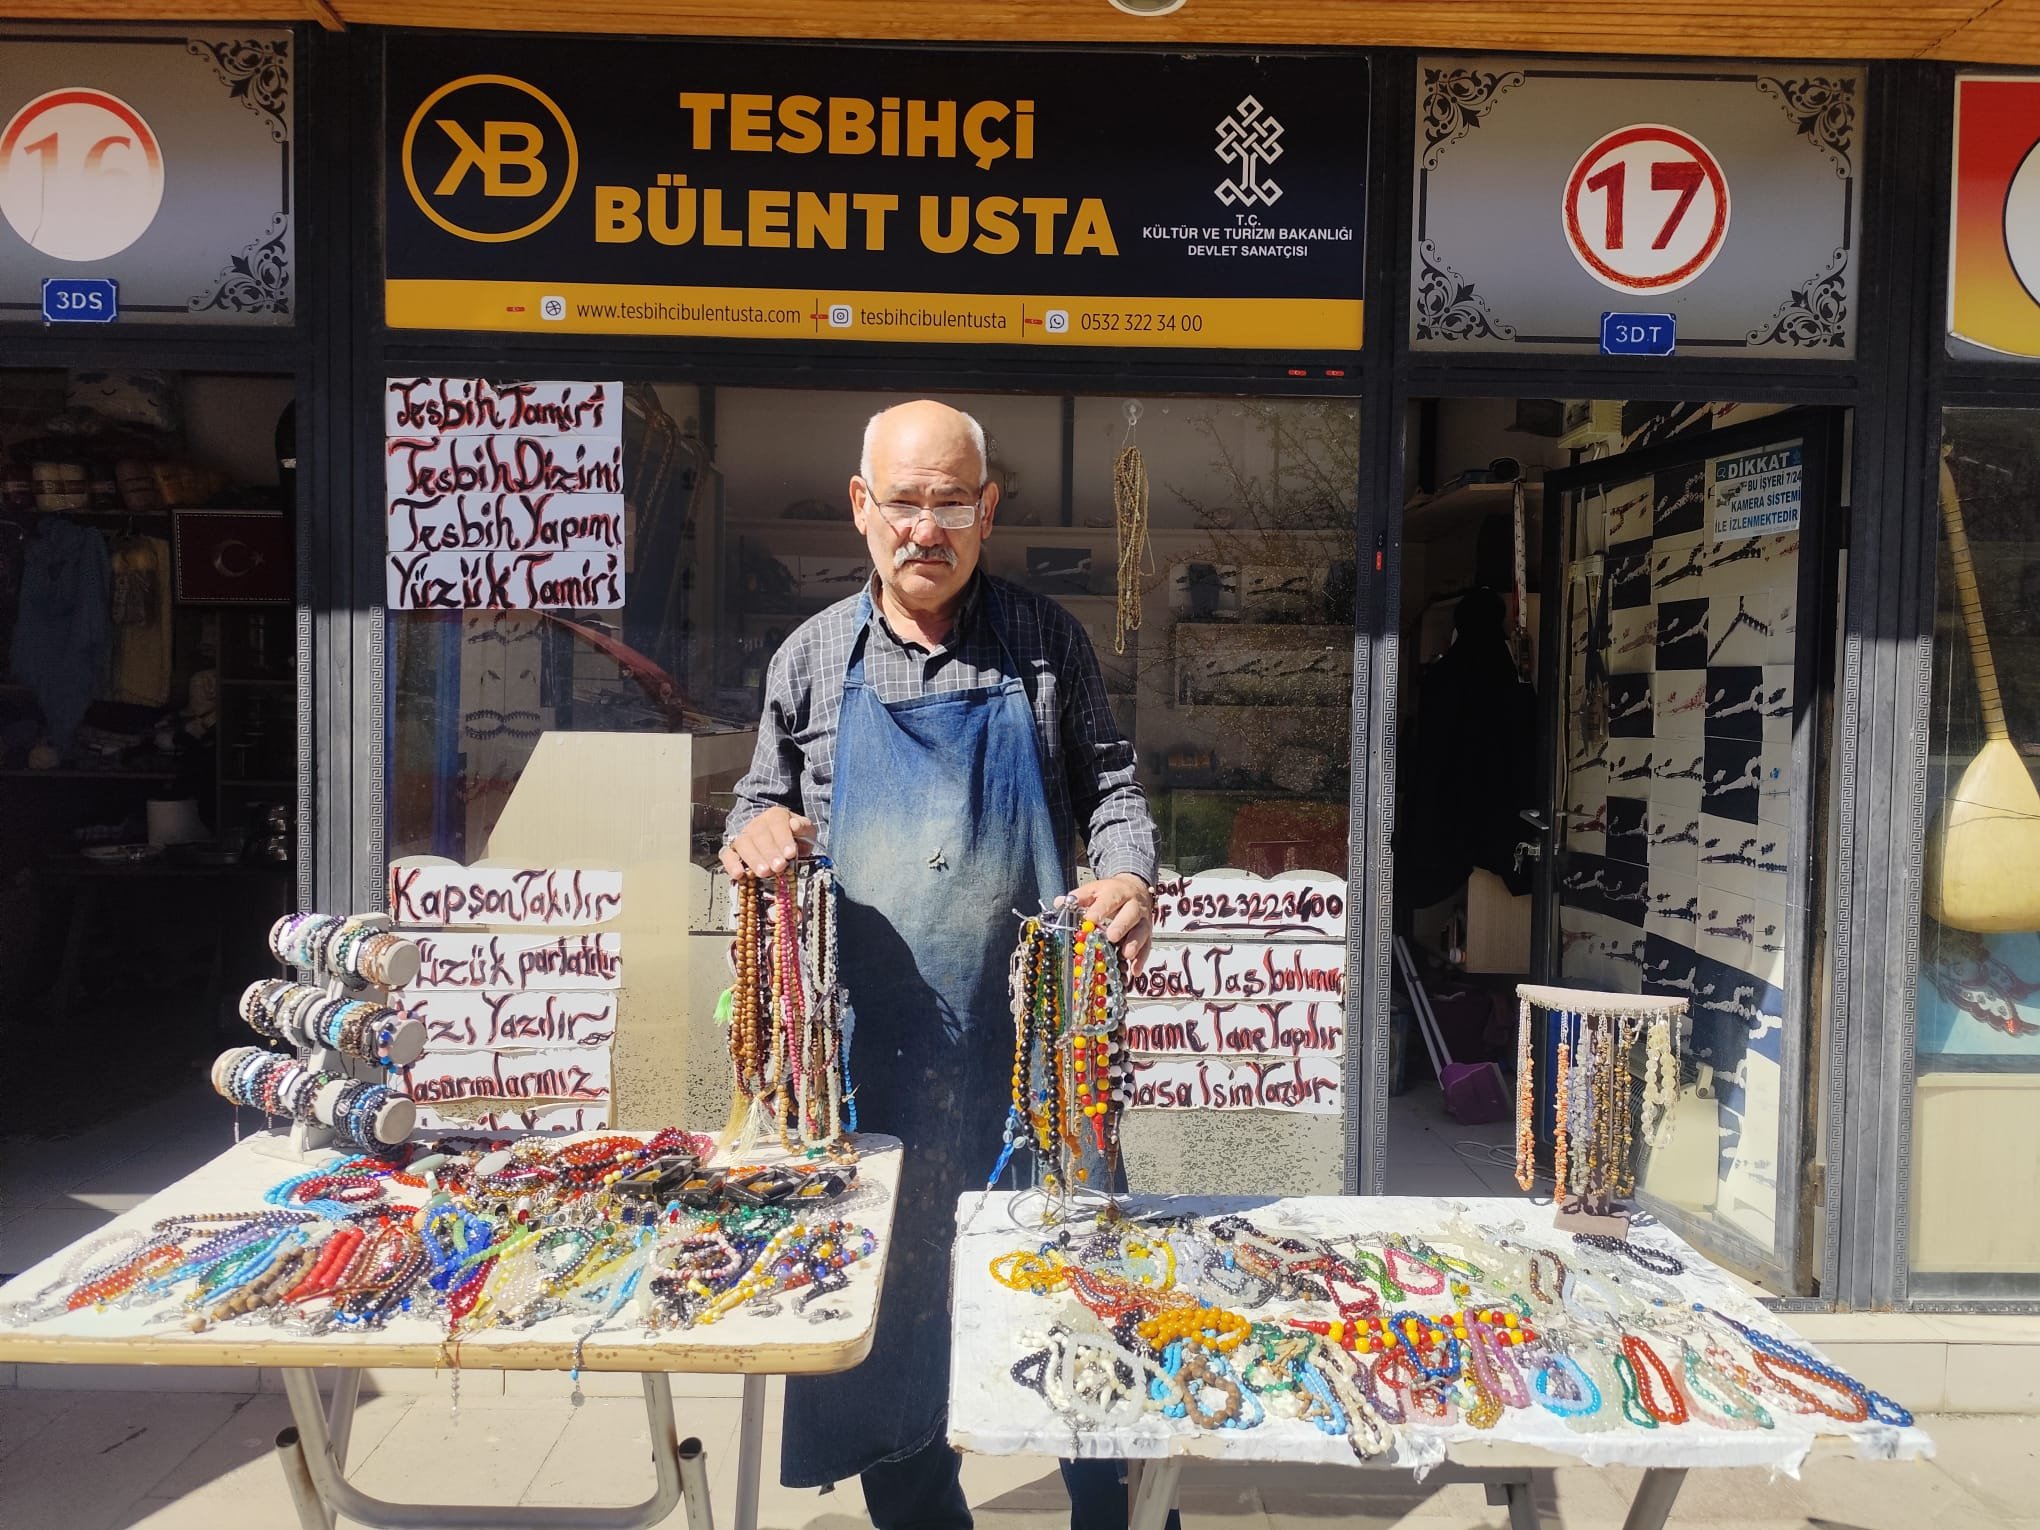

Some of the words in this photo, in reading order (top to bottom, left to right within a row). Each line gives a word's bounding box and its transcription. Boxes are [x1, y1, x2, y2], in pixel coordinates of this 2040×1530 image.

[595, 173, 899, 251] BÜLENT
[919, 195, 1119, 256] USTA
[1586, 161, 1706, 250] 17
[1142, 223, 1199, 240] KÜLTÜR
[1202, 228, 1220, 240] VE
[1223, 226, 1275, 241] TURİZM
[1278, 226, 1353, 241] BAKANLIĞI
[1187, 245, 1238, 257] DEVLET
[1240, 245, 1308, 259] SANATÇISI
[55, 290, 103, 312] 3DS
[576, 302, 801, 325] www.tesbihcibulentusta.com
[860, 308, 1007, 330] tesbihcibulentusta
[1081, 313, 1120, 331] 0532
[1124, 314, 1152, 331] 322
[1156, 314, 1177, 332] 34
[1180, 315, 1203, 332] 00
[1615, 325, 1662, 344] 3DT
[389, 377, 507, 434] Tesbih
[387, 434, 517, 497] Tesbih
[1727, 451, 1791, 480] DİKKAT
[1747, 478, 1758, 492] BU
[1759, 470, 1785, 492] İŞYERİ
[1731, 495, 1765, 513] KAMERA
[1766, 486, 1801, 508] SİSTEMİ
[389, 493, 522, 552] Tesbih
[1729, 508, 1798, 531] İZLENMEKTEDİR
[512, 552, 622, 608] Tamiri
